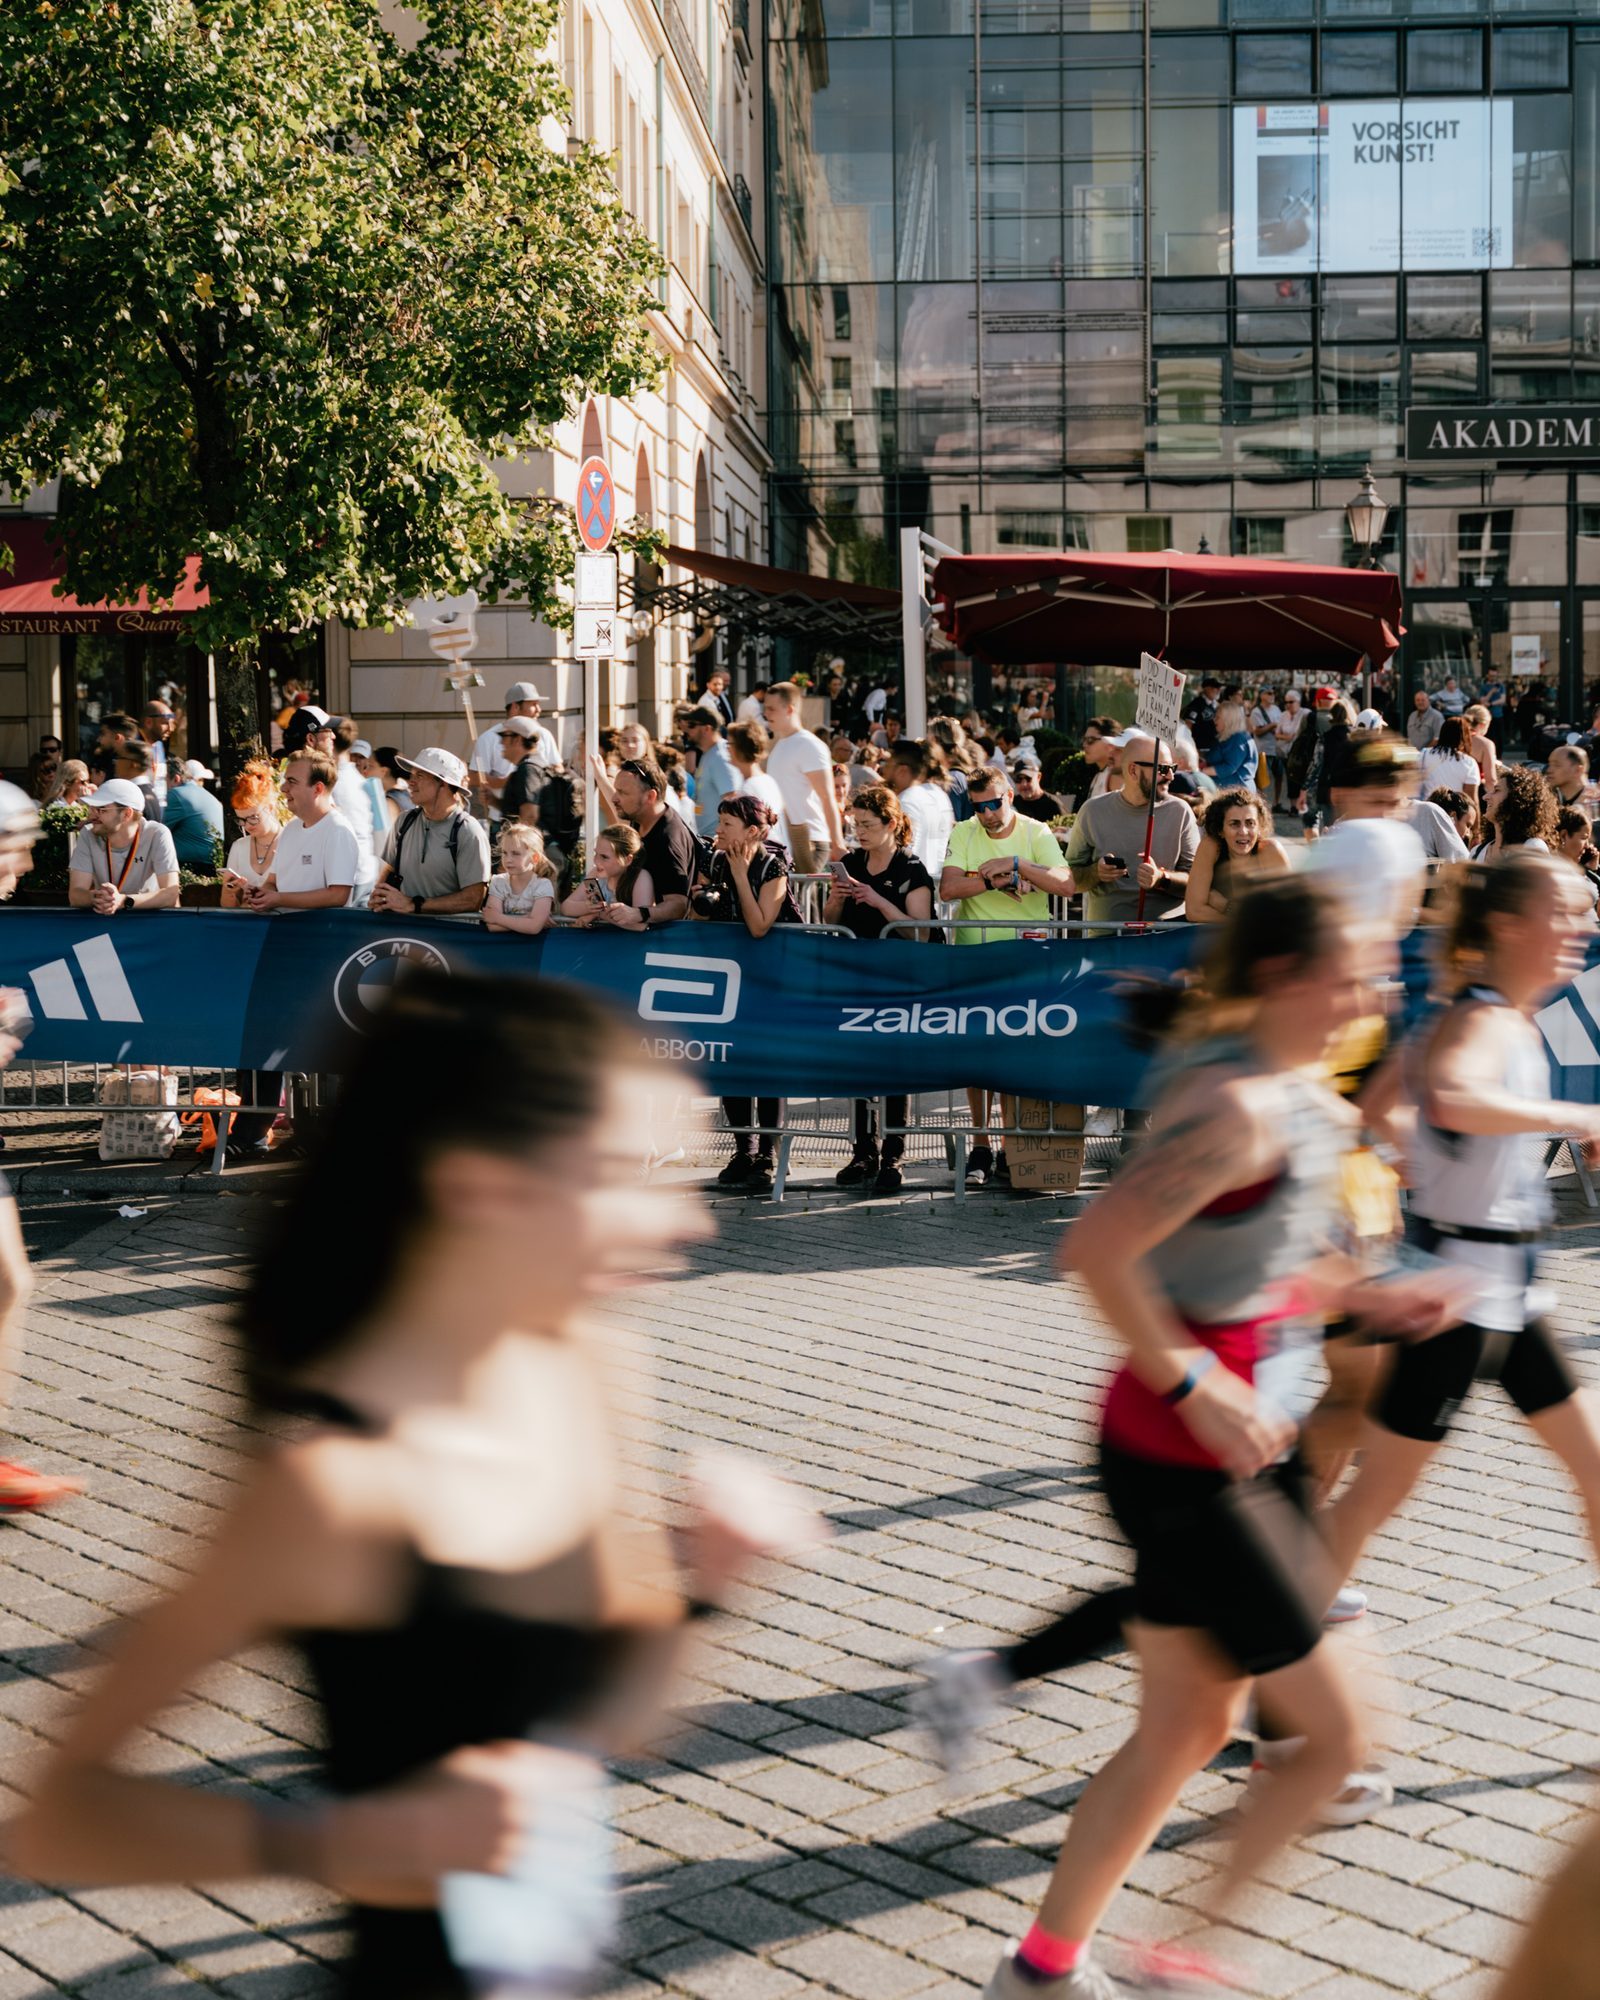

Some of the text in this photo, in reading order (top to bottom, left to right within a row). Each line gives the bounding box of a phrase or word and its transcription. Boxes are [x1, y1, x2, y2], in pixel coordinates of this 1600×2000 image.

[1352, 120, 1460, 141] VORSICHT
[1354, 143, 1434, 164] KUNST!
[1426, 418, 1600, 449] AKADEM
[0, 619, 101, 633] STAURANT
[1141, 674, 1177, 706] MENTION
[1150, 696, 1164, 715] RAN
[1164, 706, 1170, 721] A
[838, 999, 1078, 1037] zalando
[638, 1037, 734, 1063] ABBOTT
